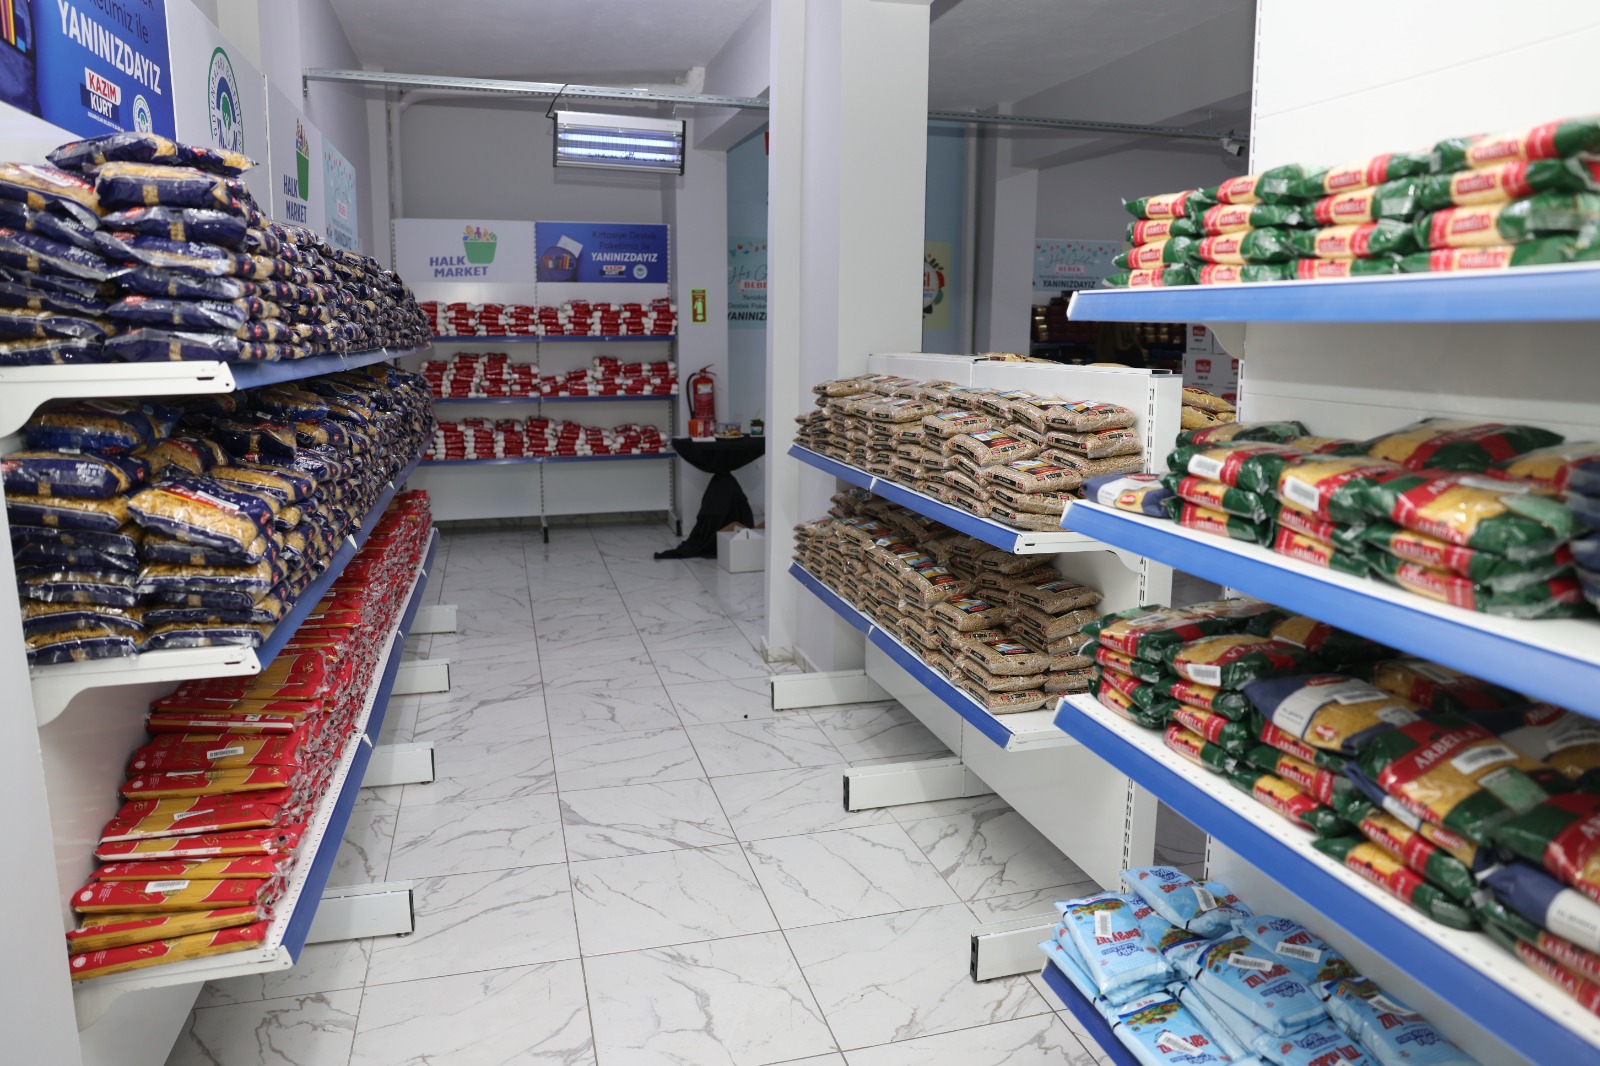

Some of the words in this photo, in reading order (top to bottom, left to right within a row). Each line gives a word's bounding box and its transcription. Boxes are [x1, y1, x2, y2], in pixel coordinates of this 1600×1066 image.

[136, 13, 148, 43] ile
[57, 0, 161, 95] YANINIZDAYIZ
[88, 72, 117, 103] KAZIM
[90, 92, 113, 118] KURT
[283, 174, 298, 198] HALK
[430, 256, 465, 268] HALK
[591, 252, 658, 262] YANINIZDAYIZ
[434, 266, 488, 278] MARKET
[1043, 280, 1096, 288] YANINIZDAYIZ
[1414, 730, 1481, 769] ARBELLA
[1547, 941, 1600, 978] ARBELL
